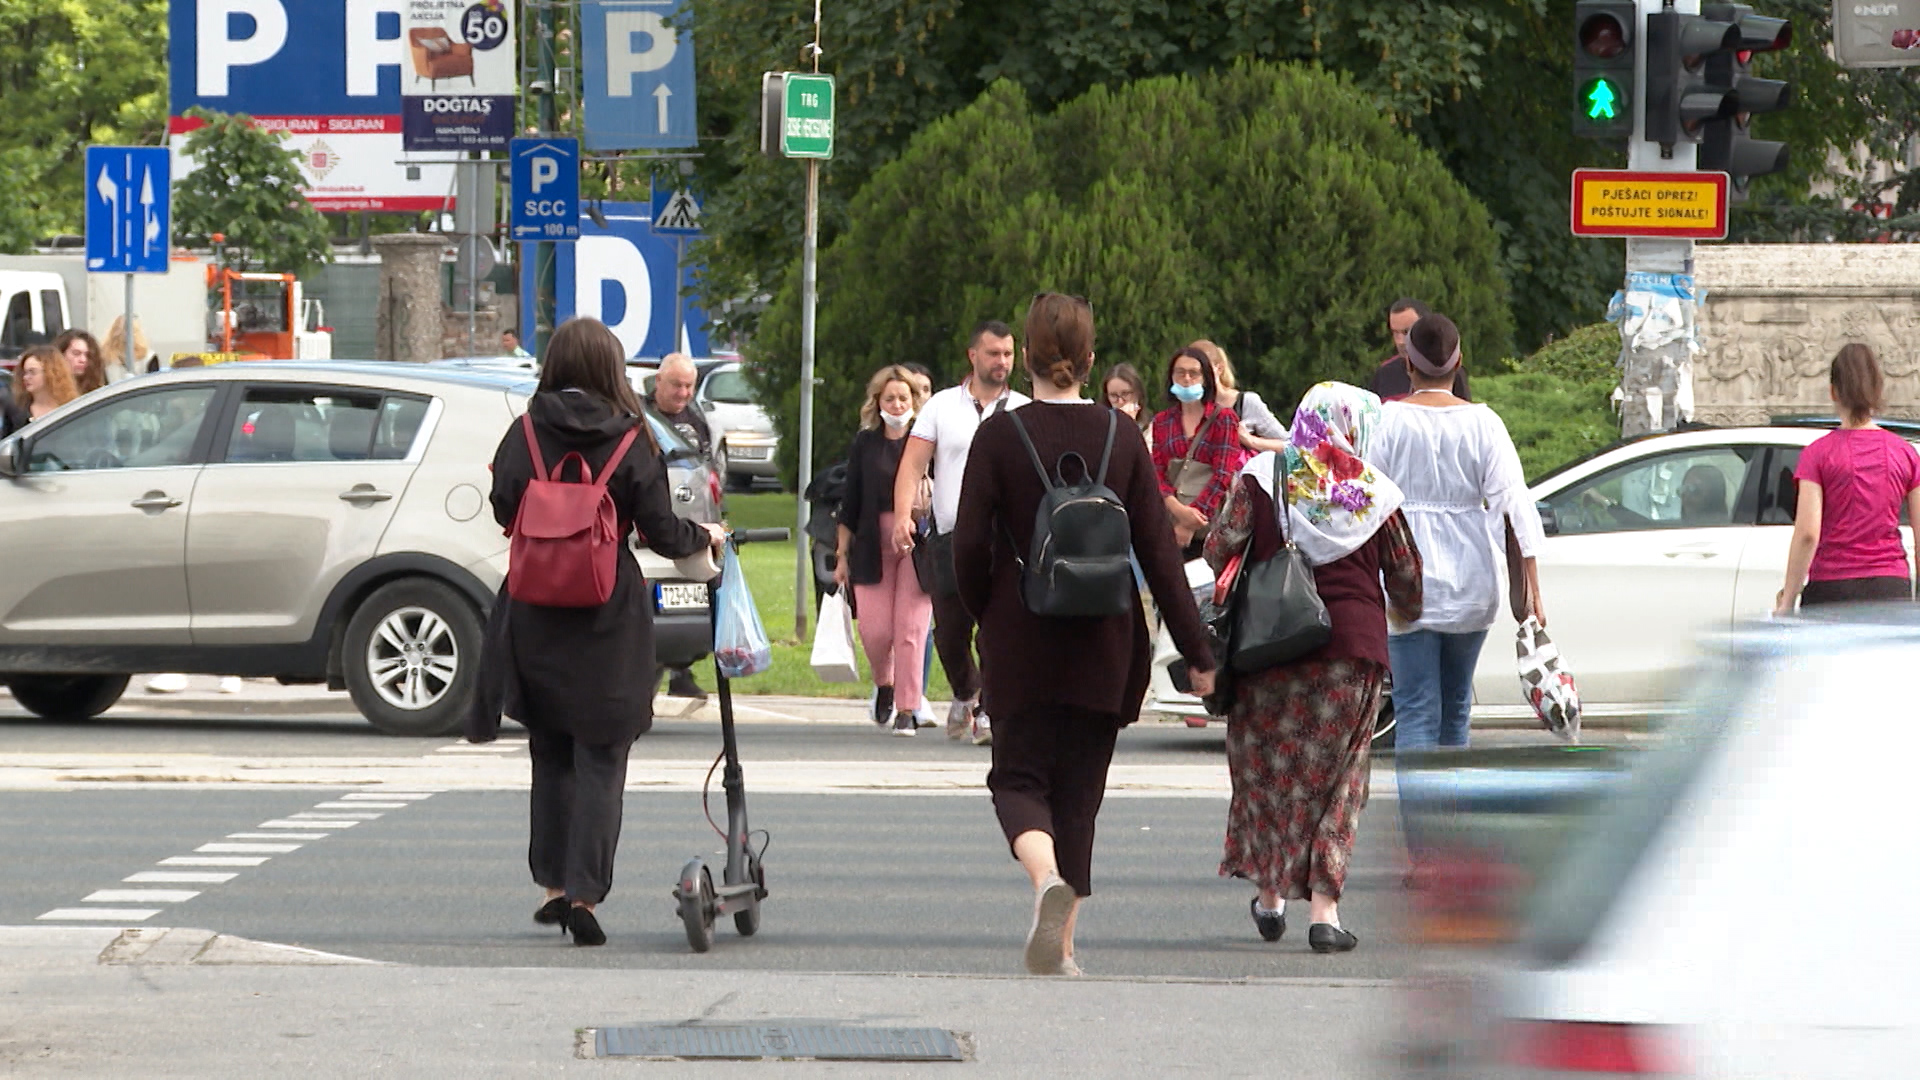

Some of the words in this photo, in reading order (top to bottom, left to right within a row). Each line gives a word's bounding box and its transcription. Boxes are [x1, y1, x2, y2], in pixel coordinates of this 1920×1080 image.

[466, 16, 504, 44] 50
[196, 0, 289, 96] P
[606, 11, 677, 97] P
[800, 93, 819, 108] TRG
[328, 119, 385, 131] SIGURAN
[531, 157, 558, 193] P
[1602, 187, 1651, 200] PJEŠACI
[1657, 190, 1698, 201] OPREZ!
[524, 200, 567, 216] SCC
[1591, 203, 1651, 218] POŠTUJTE
[1657, 208, 1709, 219] SIGNALE!
[543, 223, 564, 236] 100
[566, 225, 578, 236] m
